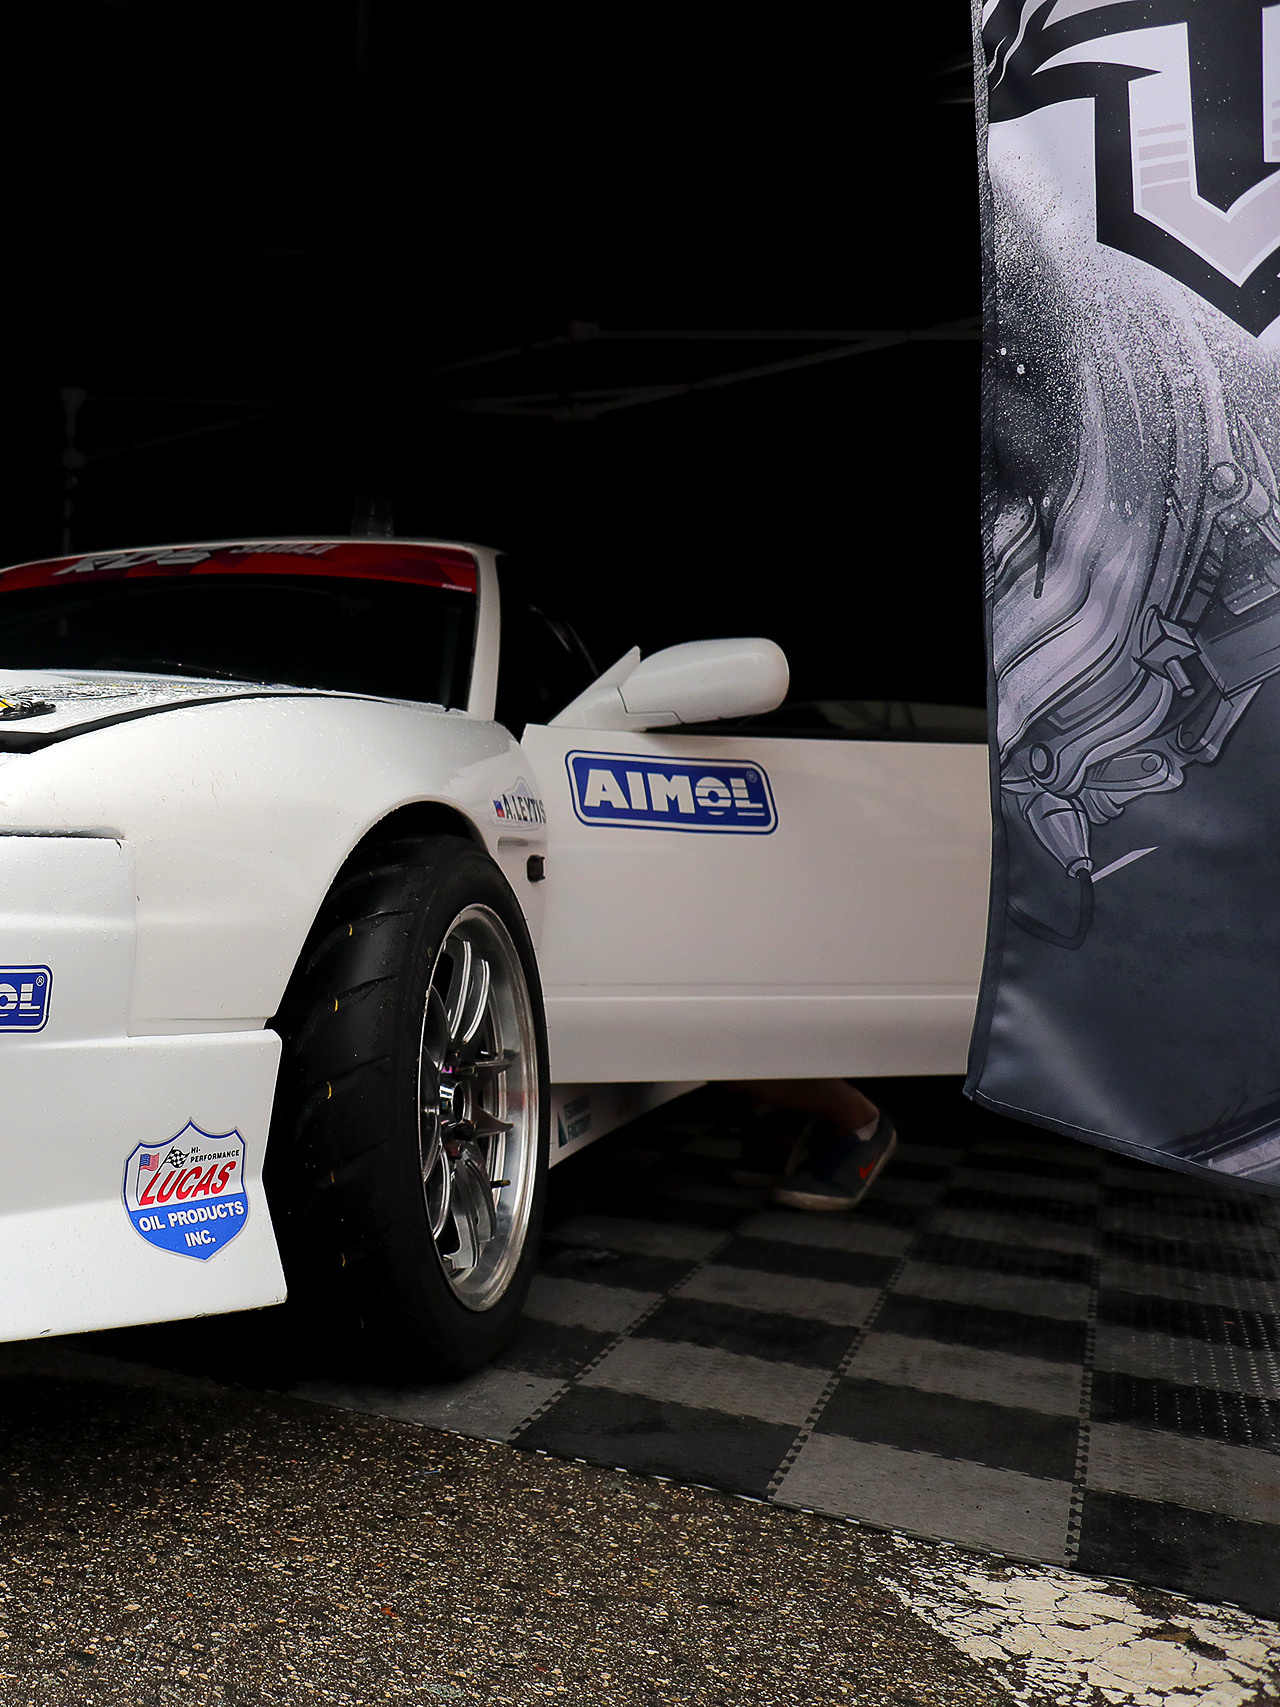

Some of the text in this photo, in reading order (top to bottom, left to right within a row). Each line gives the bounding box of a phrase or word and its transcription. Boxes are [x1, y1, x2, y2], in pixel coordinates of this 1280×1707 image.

[583, 768, 765, 817] AIMOL
[190, 1149, 240, 1163] PERFORMANCE
[139, 1161, 237, 1206] LUCAS
[138, 1201, 245, 1232] OIL PRODUCTS
[184, 1229, 216, 1248] INC.
